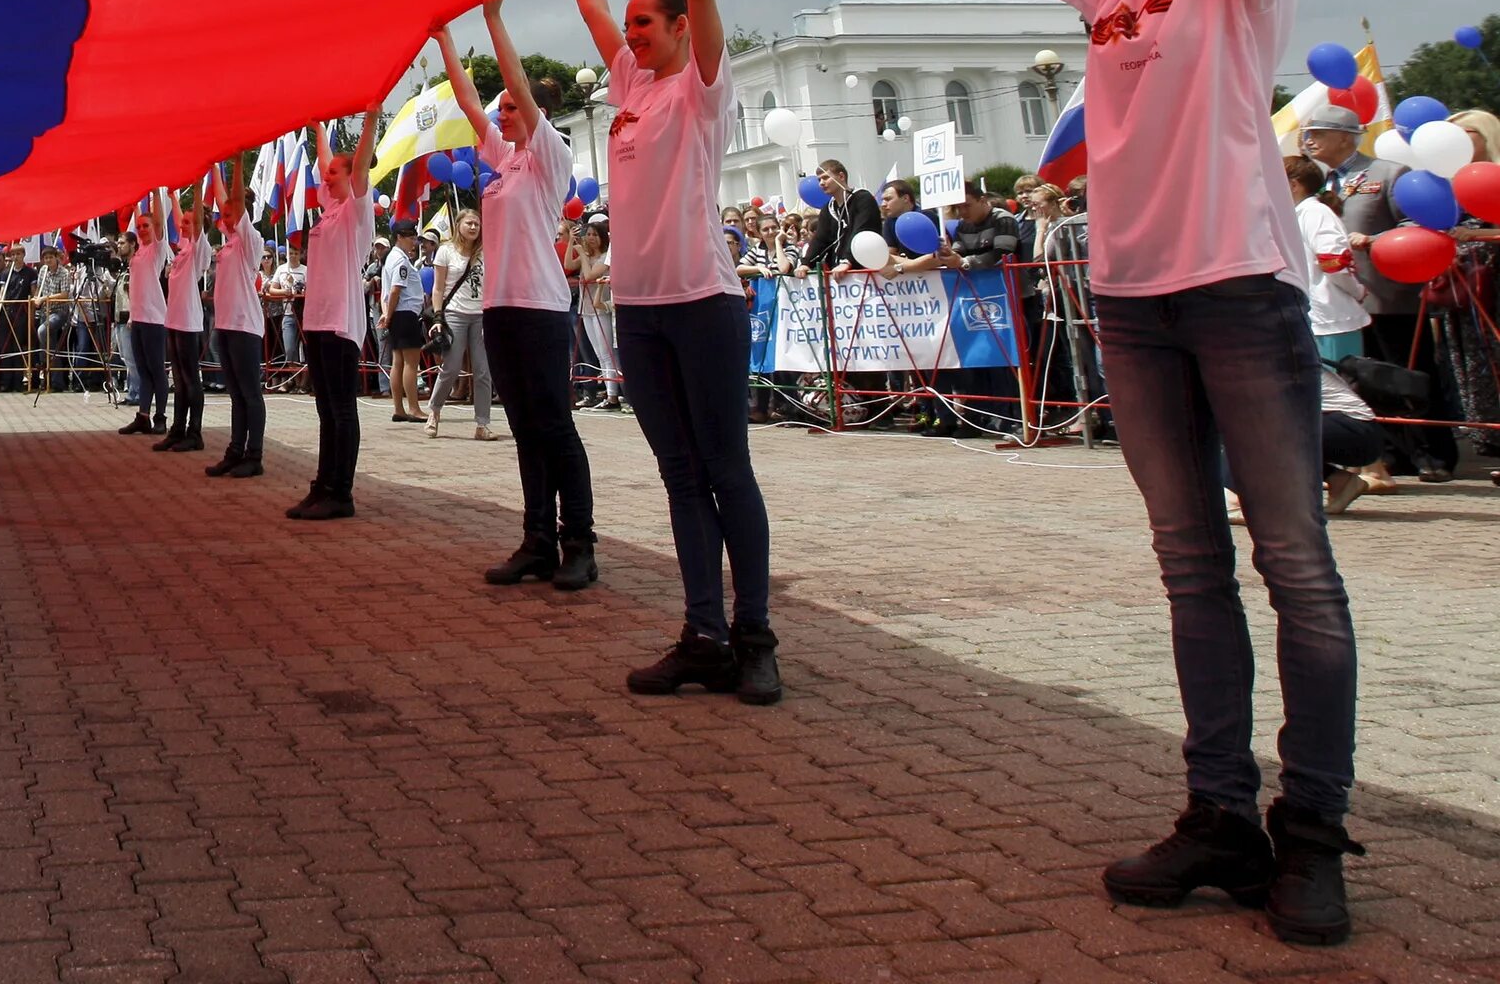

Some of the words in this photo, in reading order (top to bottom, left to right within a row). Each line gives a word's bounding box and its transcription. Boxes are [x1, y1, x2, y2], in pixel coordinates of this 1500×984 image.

[923, 169, 961, 195] СГПИ
[781, 296, 941, 323] ГОСУДРСТВЕННЫЙ
[786, 318, 935, 344] ПЕДАОГИЧЕСКИЙ
